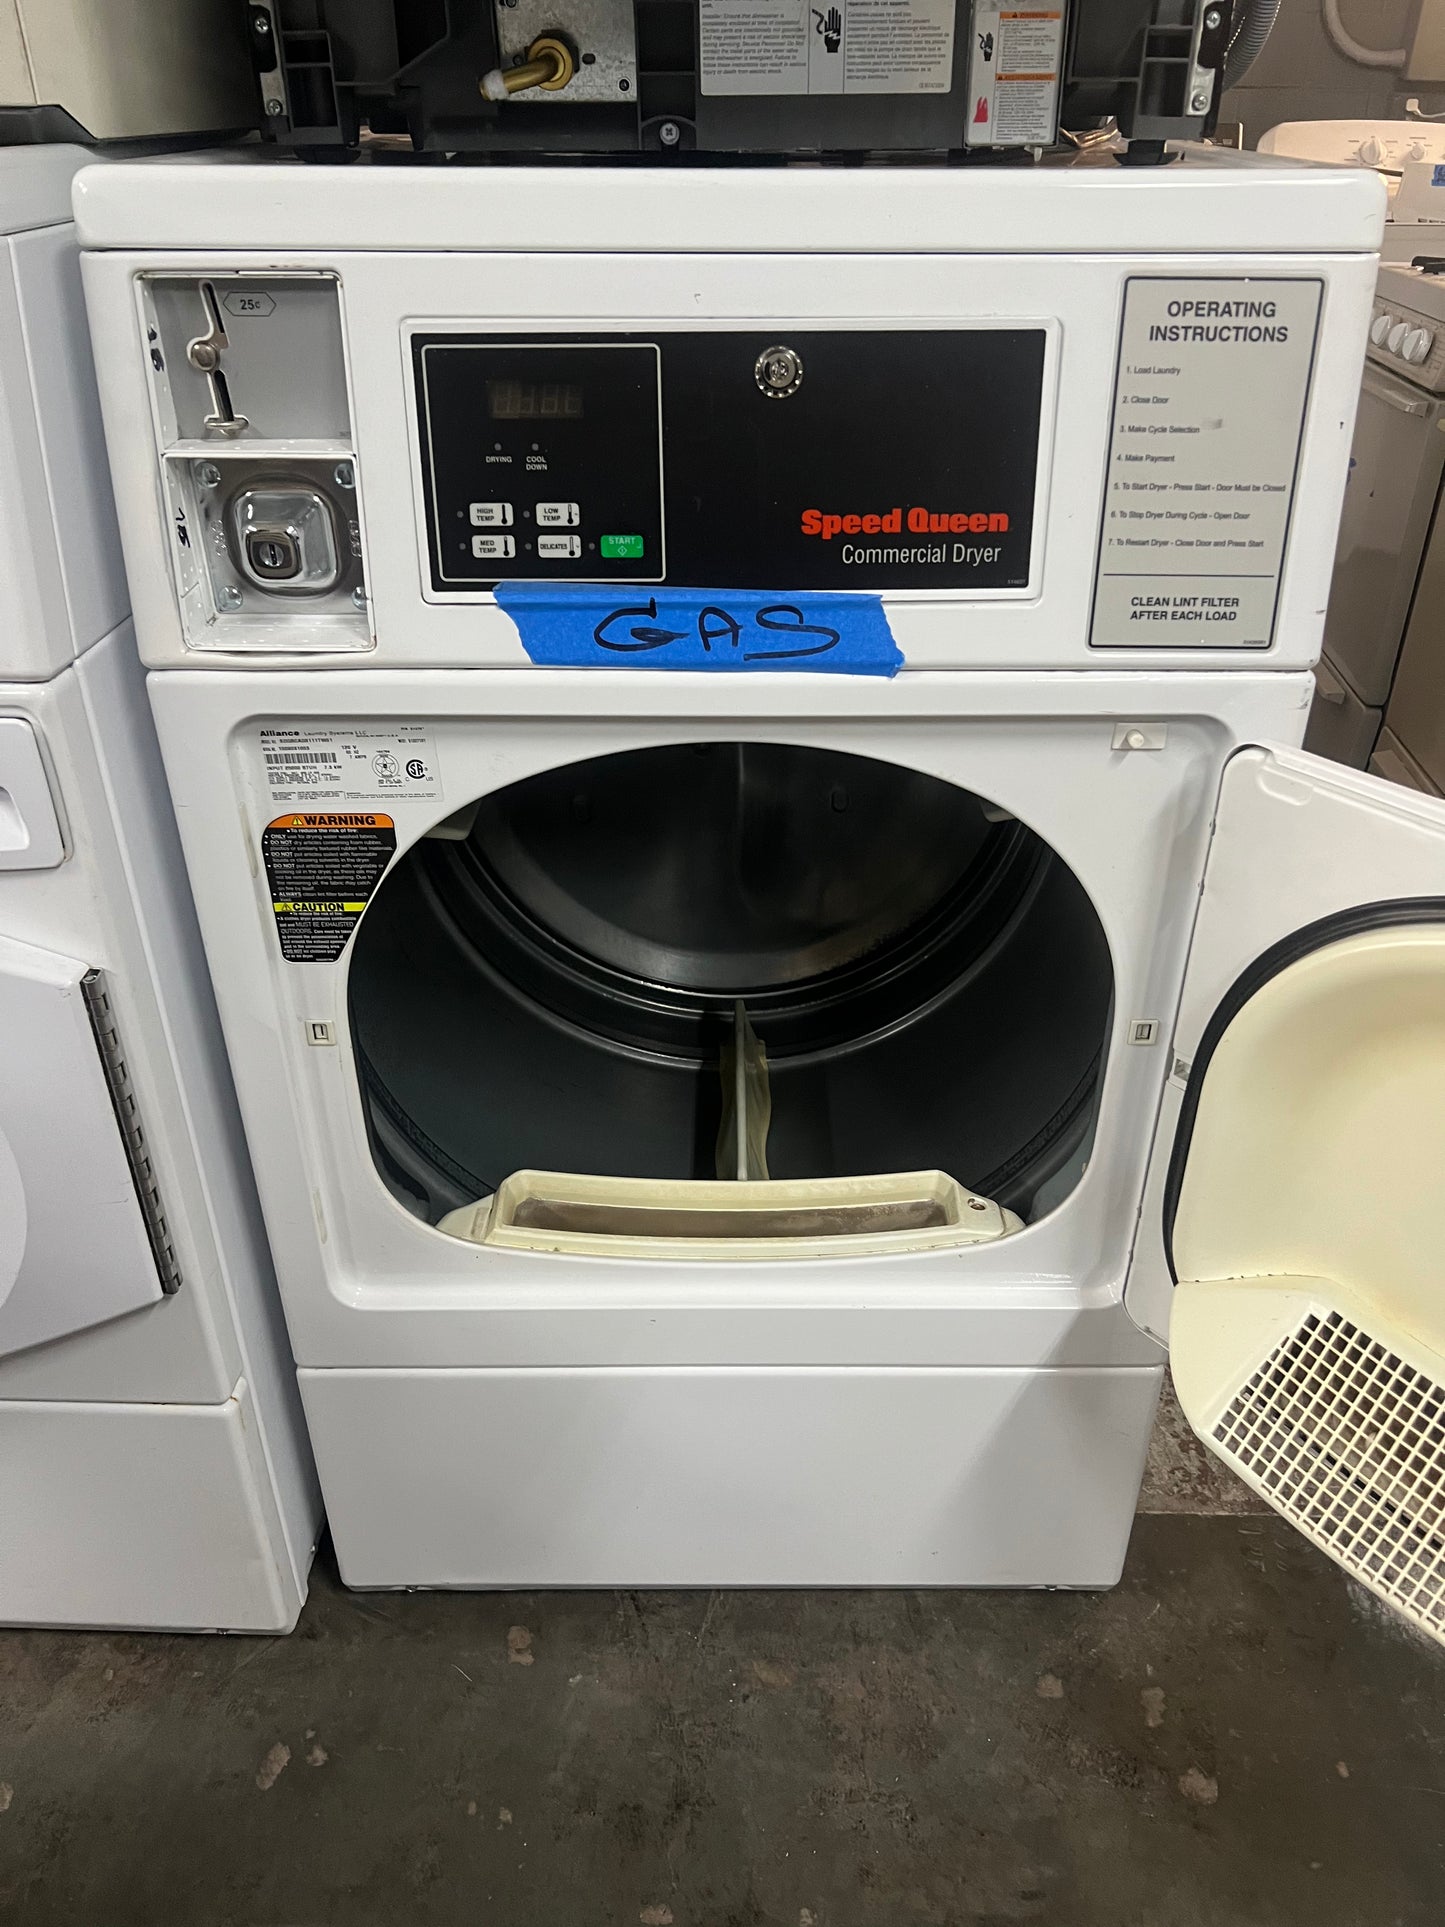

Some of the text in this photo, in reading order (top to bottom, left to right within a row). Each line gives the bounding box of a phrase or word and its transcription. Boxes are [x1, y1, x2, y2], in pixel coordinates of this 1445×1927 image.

[1167, 301, 1276, 318] OPERATING
[1149, 325, 1288, 342] INSTRUCTIONS
[1153, 367, 1181, 376] Laundry
[1148, 426, 1167, 434] Cycle
[1145, 455, 1175, 463] Payment
[1149, 484, 1168, 492] Dryer
[1129, 512, 1144, 520] Stop
[1146, 512, 1164, 520] Dryer
[1166, 512, 1187, 520] During
[1189, 512, 1208, 520] Cycle
[801, 507, 1009, 540] Speed Queen
[1151, 539, 1169, 547] Dryer
[842, 543, 1002, 566] Commercial Dryer
[1131, 597, 1239, 607] CLEAN LINT FILTER
[1130, 611, 1236, 621] AFTER EACH LOAD
[594, 597, 841, 661] GAS
[406, 759, 425, 779] CSA
[303, 816, 376, 825] WARNING
